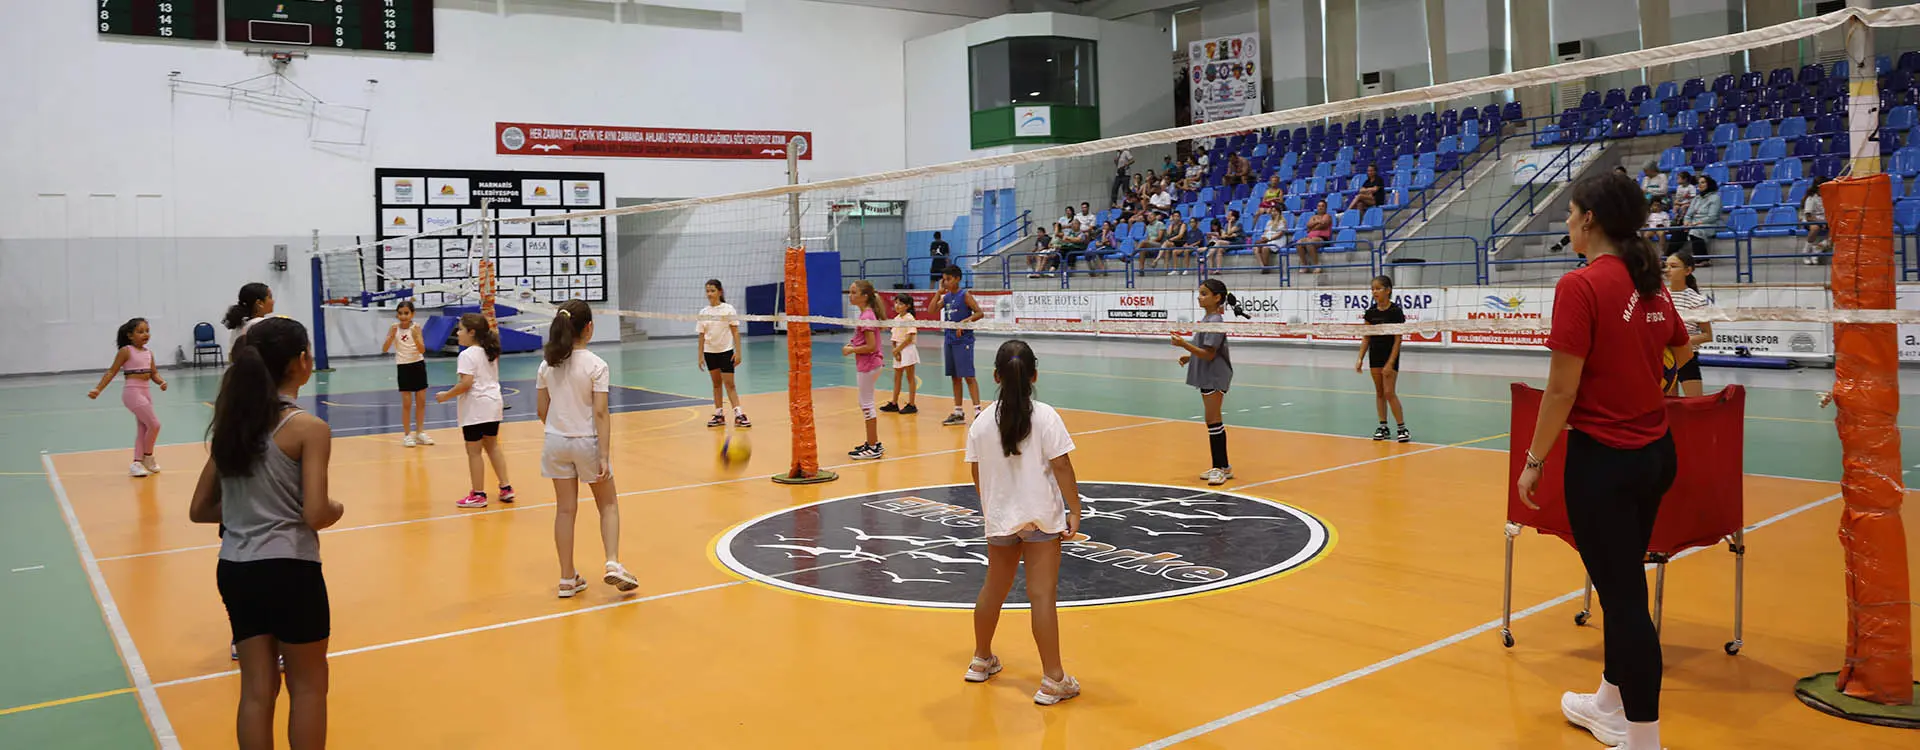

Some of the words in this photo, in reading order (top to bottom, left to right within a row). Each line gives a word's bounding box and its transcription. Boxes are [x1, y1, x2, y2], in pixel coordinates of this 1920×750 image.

[159, 3, 172, 12] 13
[335, 5, 343, 13] 6
[100, 10, 109, 19] 8
[384, 9, 396, 18] 12
[159, 15, 172, 24] 14
[336, 16, 343, 24] 7
[384, 20, 396, 28] 13
[101, 22, 109, 32] 9
[159, 27, 173, 36] 15
[335, 27, 343, 35] 8
[384, 31, 396, 39] 14
[336, 38, 343, 47] 9
[384, 42, 396, 50] 15
[1028, 295, 1052, 305] EMRE
[1055, 295, 1089, 306] HOTELS
[1396, 295, 1432, 309] ASAP
[1756, 335, 1779, 345] SPOR
